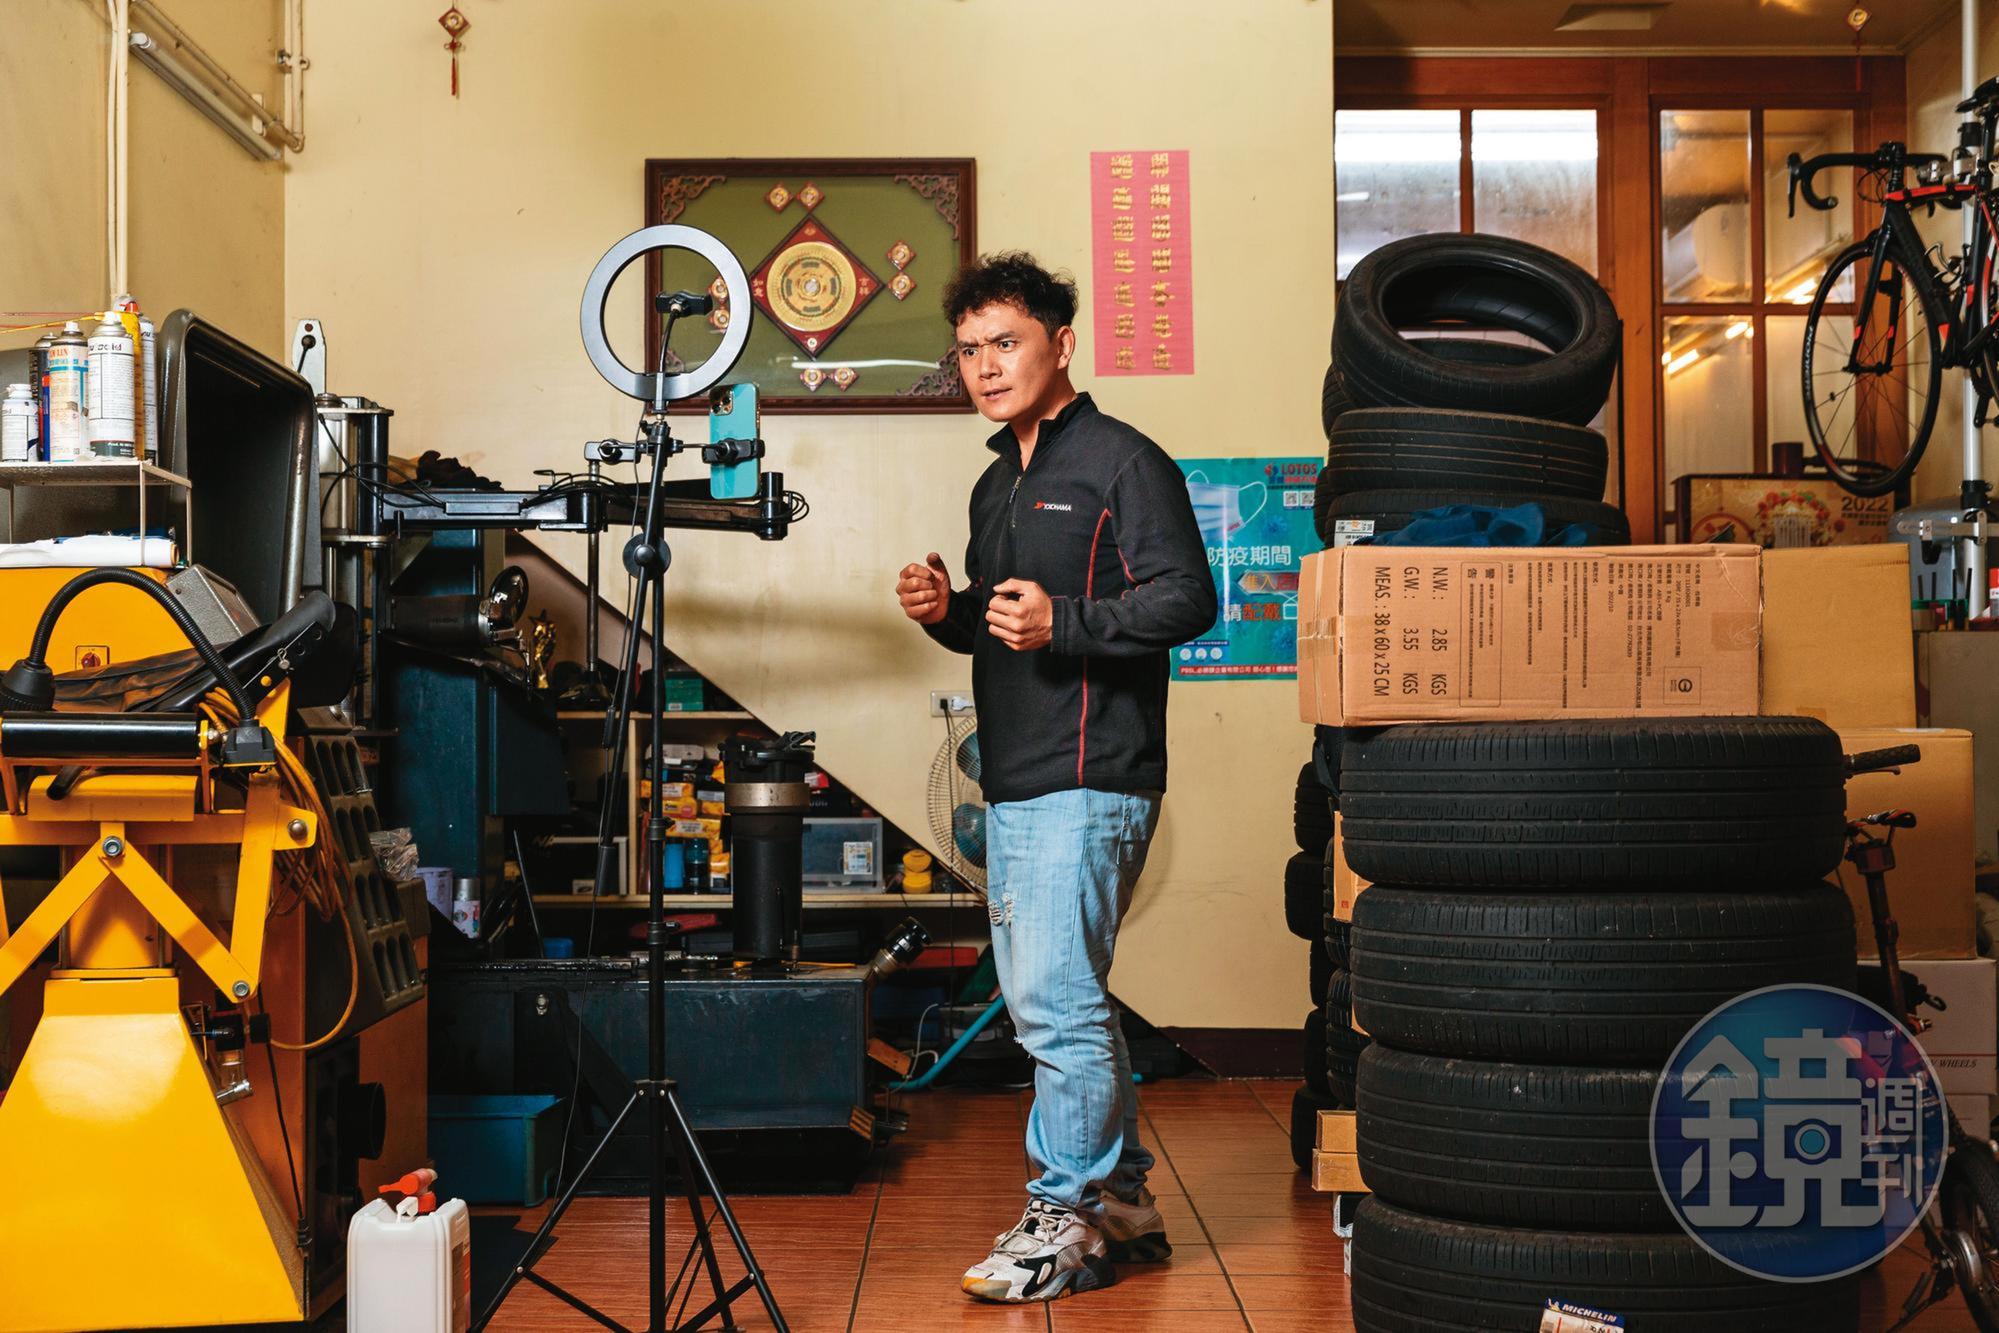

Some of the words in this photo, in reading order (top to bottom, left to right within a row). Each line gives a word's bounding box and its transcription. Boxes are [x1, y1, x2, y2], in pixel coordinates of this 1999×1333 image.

[1841, 496, 1888, 511] 2022
[1207, 546, 1291, 566] 防疫期間
[1246, 573, 1299, 590] 進入店
[1224, 603, 1281, 622] 請配戴
[1374, 613, 1390, 625] 38
[1374, 637, 1390, 650] 60
[1403, 628, 1418, 650] 3.55
[1432, 628, 1447, 651] 2.85
[1374, 662, 1389, 674] 25
[1374, 678, 1389, 696] CM
[1403, 673, 1418, 694] KGS
[1431, 674, 1447, 695] KGS
[1939, 1059, 1977, 1068] WHEELS
[1562, 1303, 1618, 1323] MICHELIN
